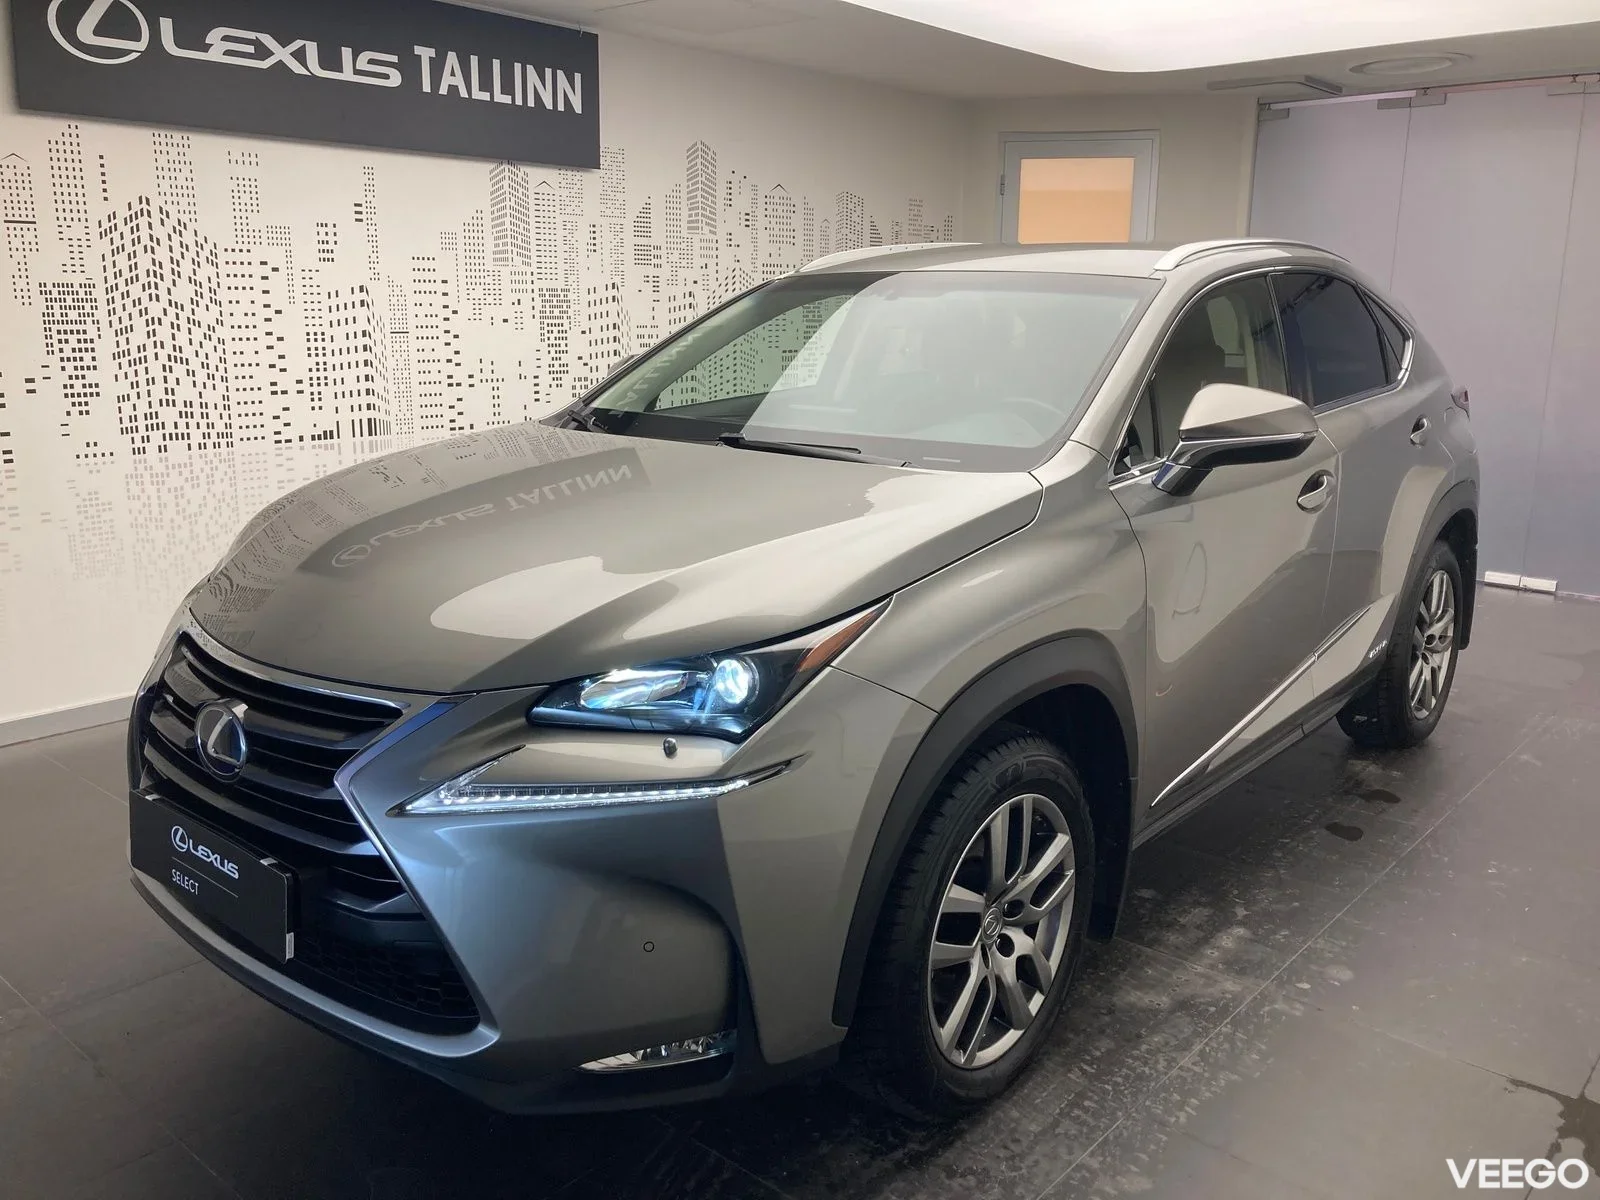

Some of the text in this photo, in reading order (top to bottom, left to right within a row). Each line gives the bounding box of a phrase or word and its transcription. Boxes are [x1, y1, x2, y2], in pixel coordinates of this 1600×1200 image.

[159, 17, 583, 114] LEXUS TALLINN
[189, 839, 239, 880] LEXUS
[171, 869, 199, 895] SELECT
